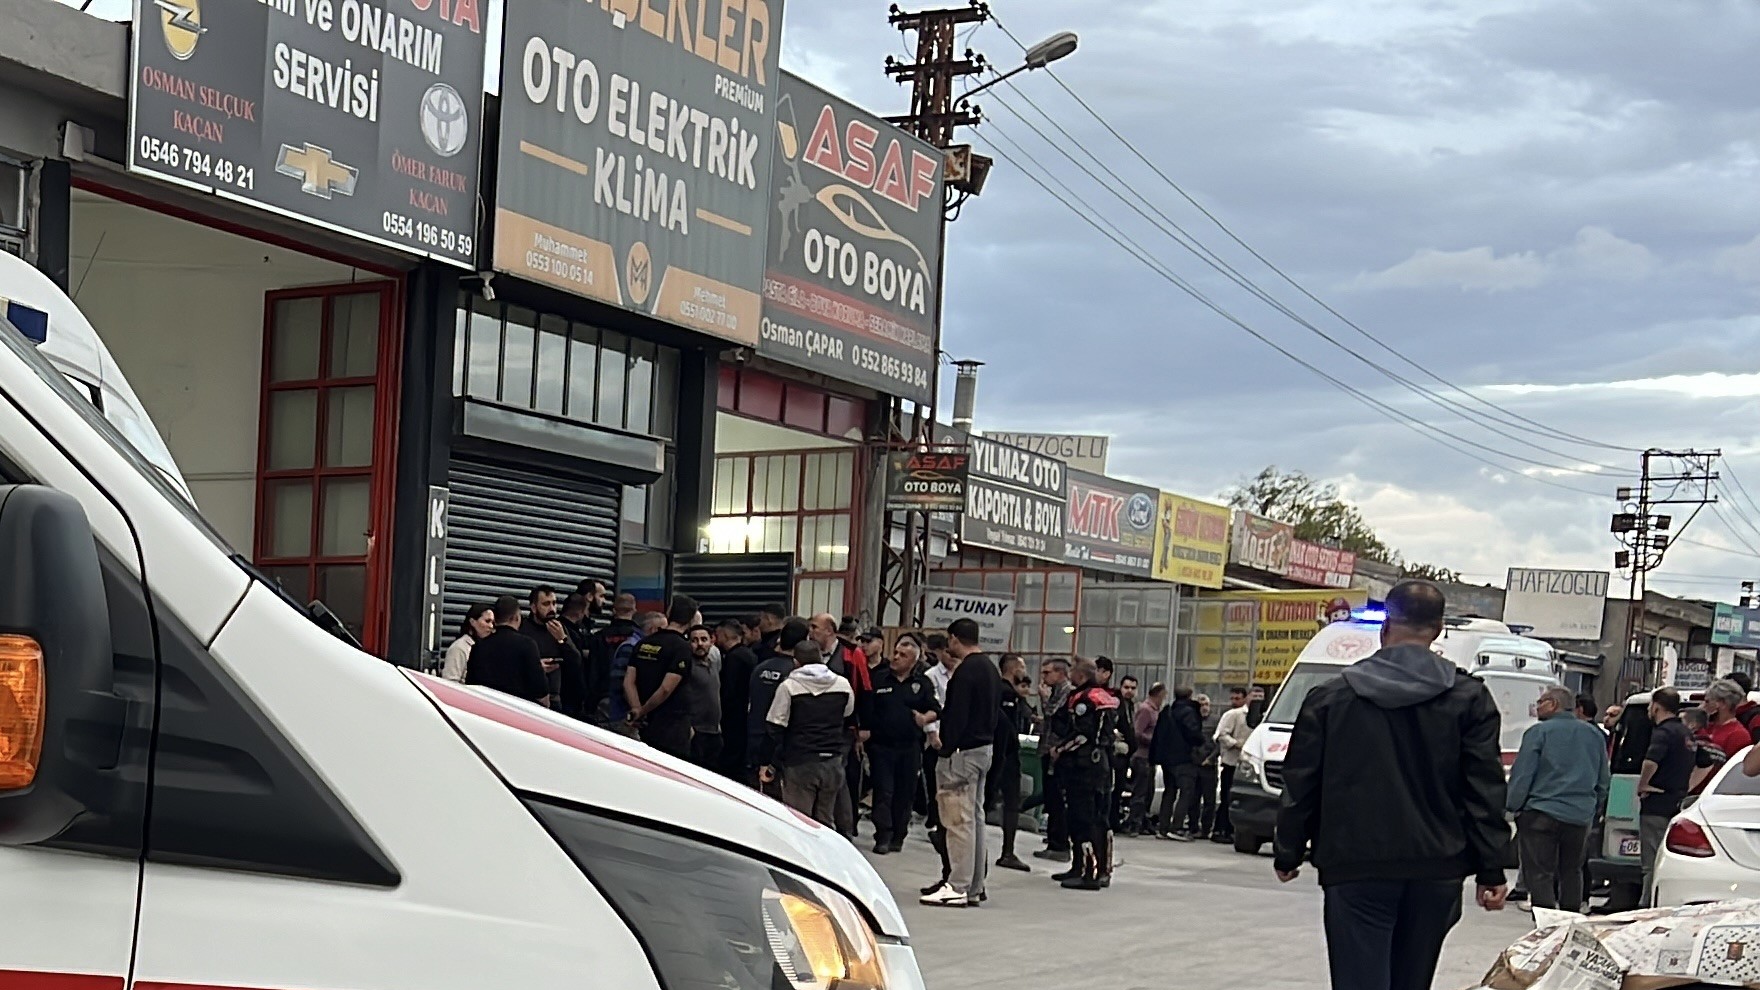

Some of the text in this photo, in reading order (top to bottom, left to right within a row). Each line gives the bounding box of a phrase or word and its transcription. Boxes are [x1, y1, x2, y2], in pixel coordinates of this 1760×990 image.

[304, 0, 333, 32] ve
[341, 0, 443, 75] ONARIM
[142, 66, 257, 123] OSMAN SELÇUK
[273, 42, 378, 123] SERVİSİ
[172, 110, 224, 145] KAÇAN
[523, 37, 758, 189] OTO ELEKTRİK
[140, 135, 254, 190] 0546 794 48 21
[391, 148, 468, 193] ÖMER FARUK
[803, 104, 938, 212] ASAF
[593, 147, 688, 235] KLİMA
[382, 211, 472, 256] 0554 196 50 59
[534, 232, 588, 264] Muhammet
[526, 250, 593, 286] 0553 100 05 14
[804, 228, 925, 315] OTO BOYA
[761, 317, 927, 390] Osman ÇAPAR 0 552 865 93 84
[904, 481, 962, 494] OTO BOYA
[906, 456, 966, 470] ASAF
[973, 439, 1060, 492] YILMAZ OTO
[969, 485, 1062, 538] KAPORTA & BOYA
[1067, 485, 1124, 542] MTK
[933, 596, 1008, 617] ALTUNAY
